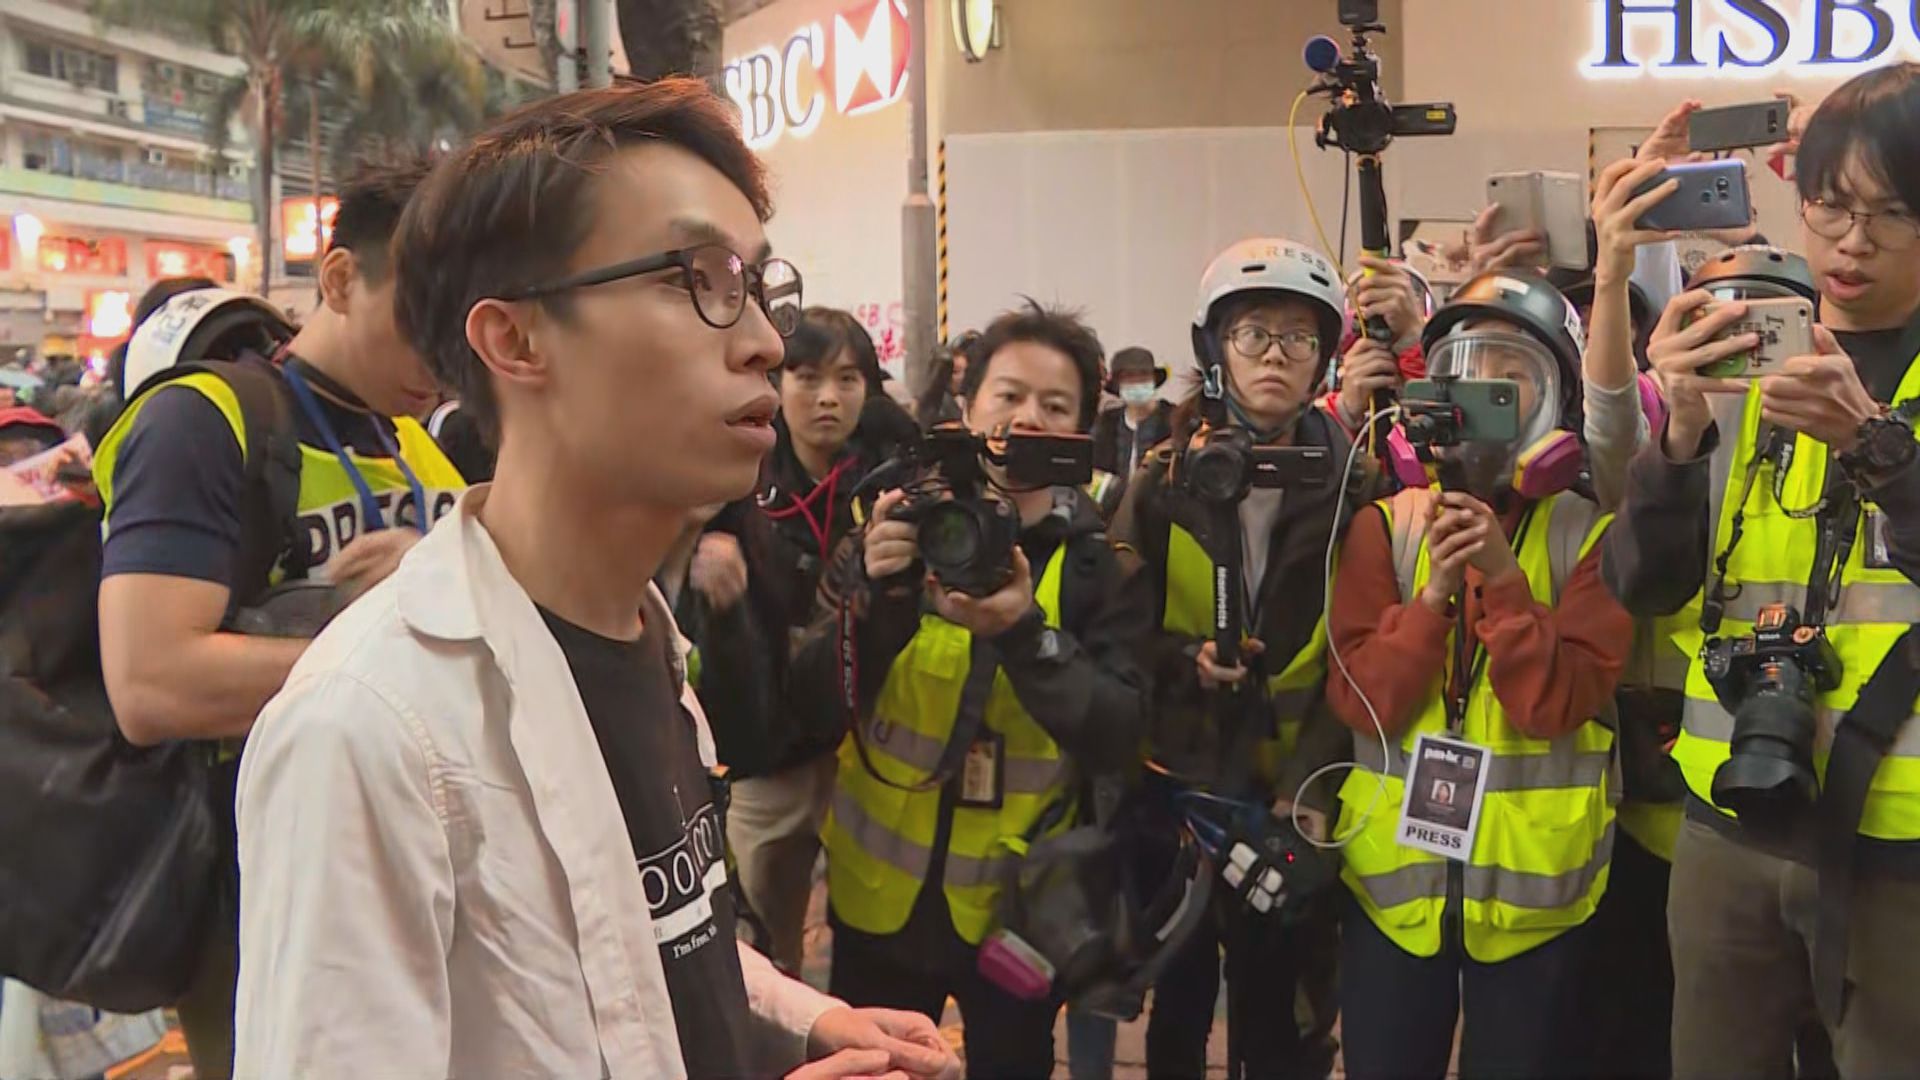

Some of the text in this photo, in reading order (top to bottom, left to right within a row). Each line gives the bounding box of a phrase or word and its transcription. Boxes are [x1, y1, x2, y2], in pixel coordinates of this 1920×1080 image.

[1590, 0, 1919, 68] HSB
[724, 28, 821, 141] SBC
[1406, 825, 1462, 850] PRESS
